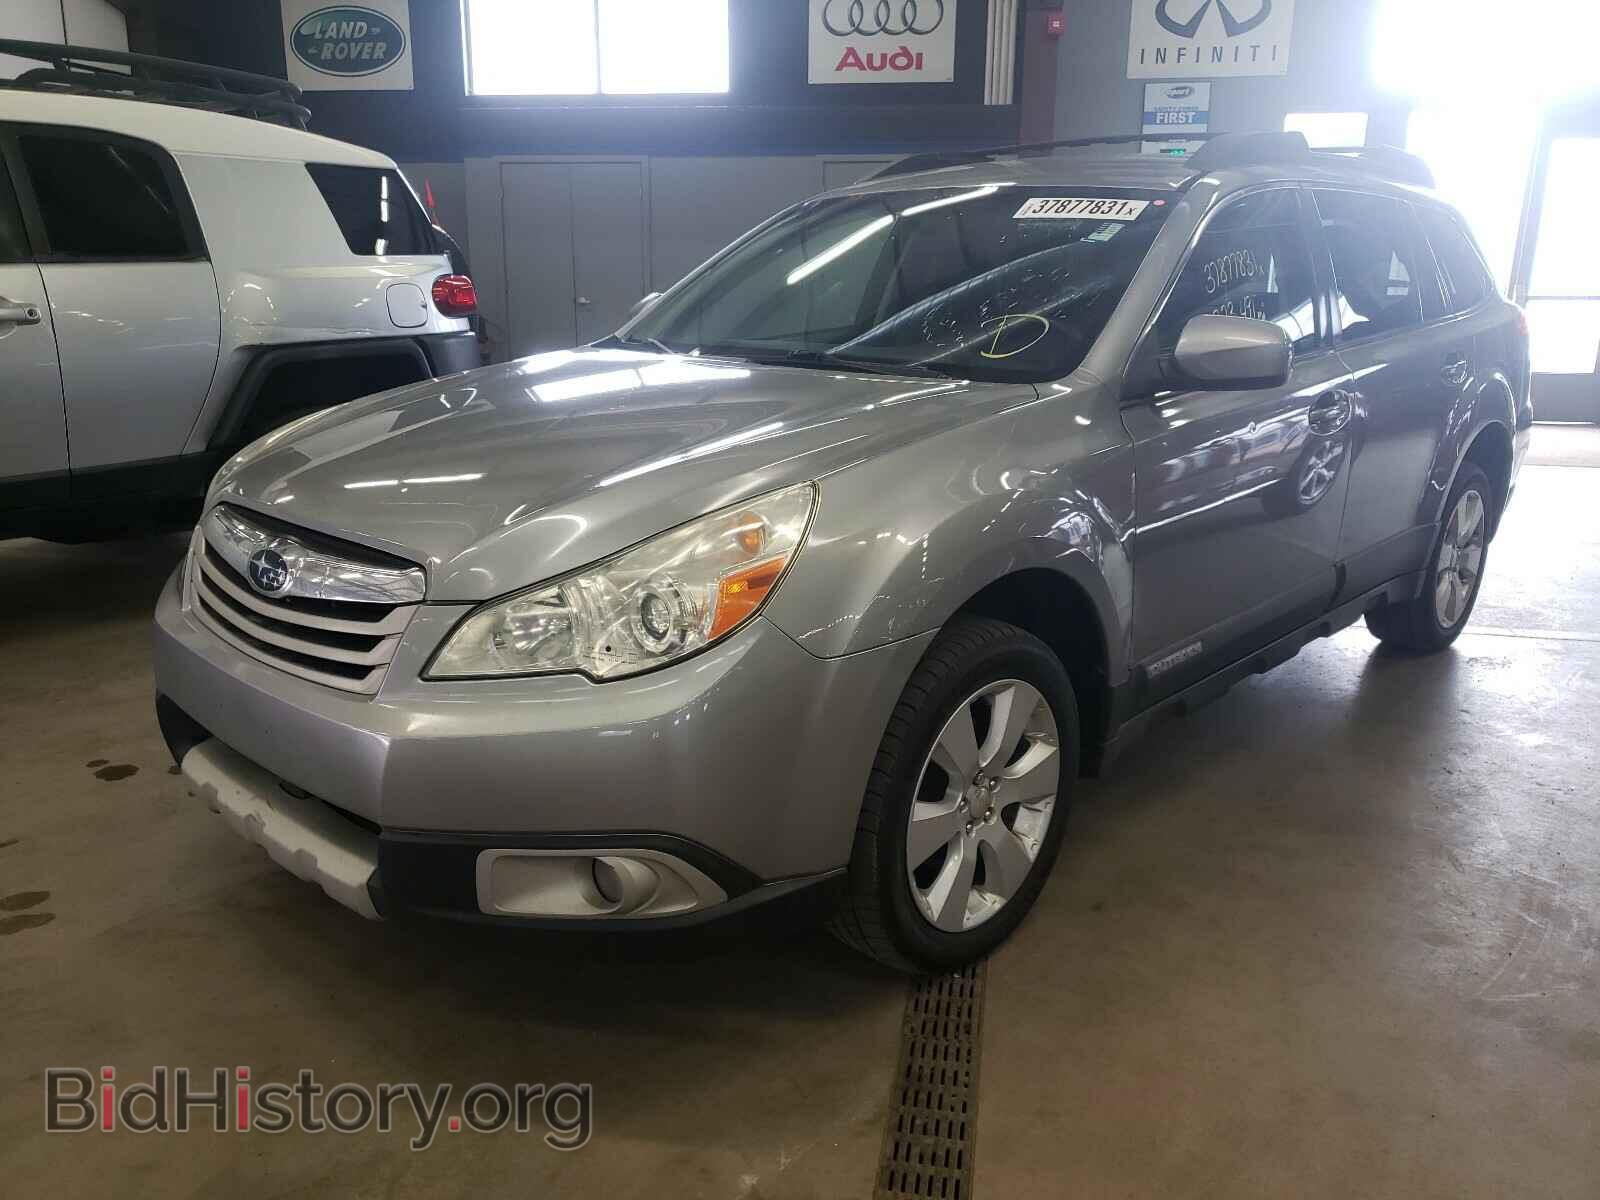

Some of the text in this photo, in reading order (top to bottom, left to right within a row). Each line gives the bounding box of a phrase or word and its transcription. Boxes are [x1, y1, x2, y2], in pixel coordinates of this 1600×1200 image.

[313, 21, 368, 39] LAND
[320, 42, 387, 60] ROVER
[835, 46, 924, 71] Audi
[1139, 44, 1277, 65] INFINITI
[1156, 112, 1196, 124] FIRST
